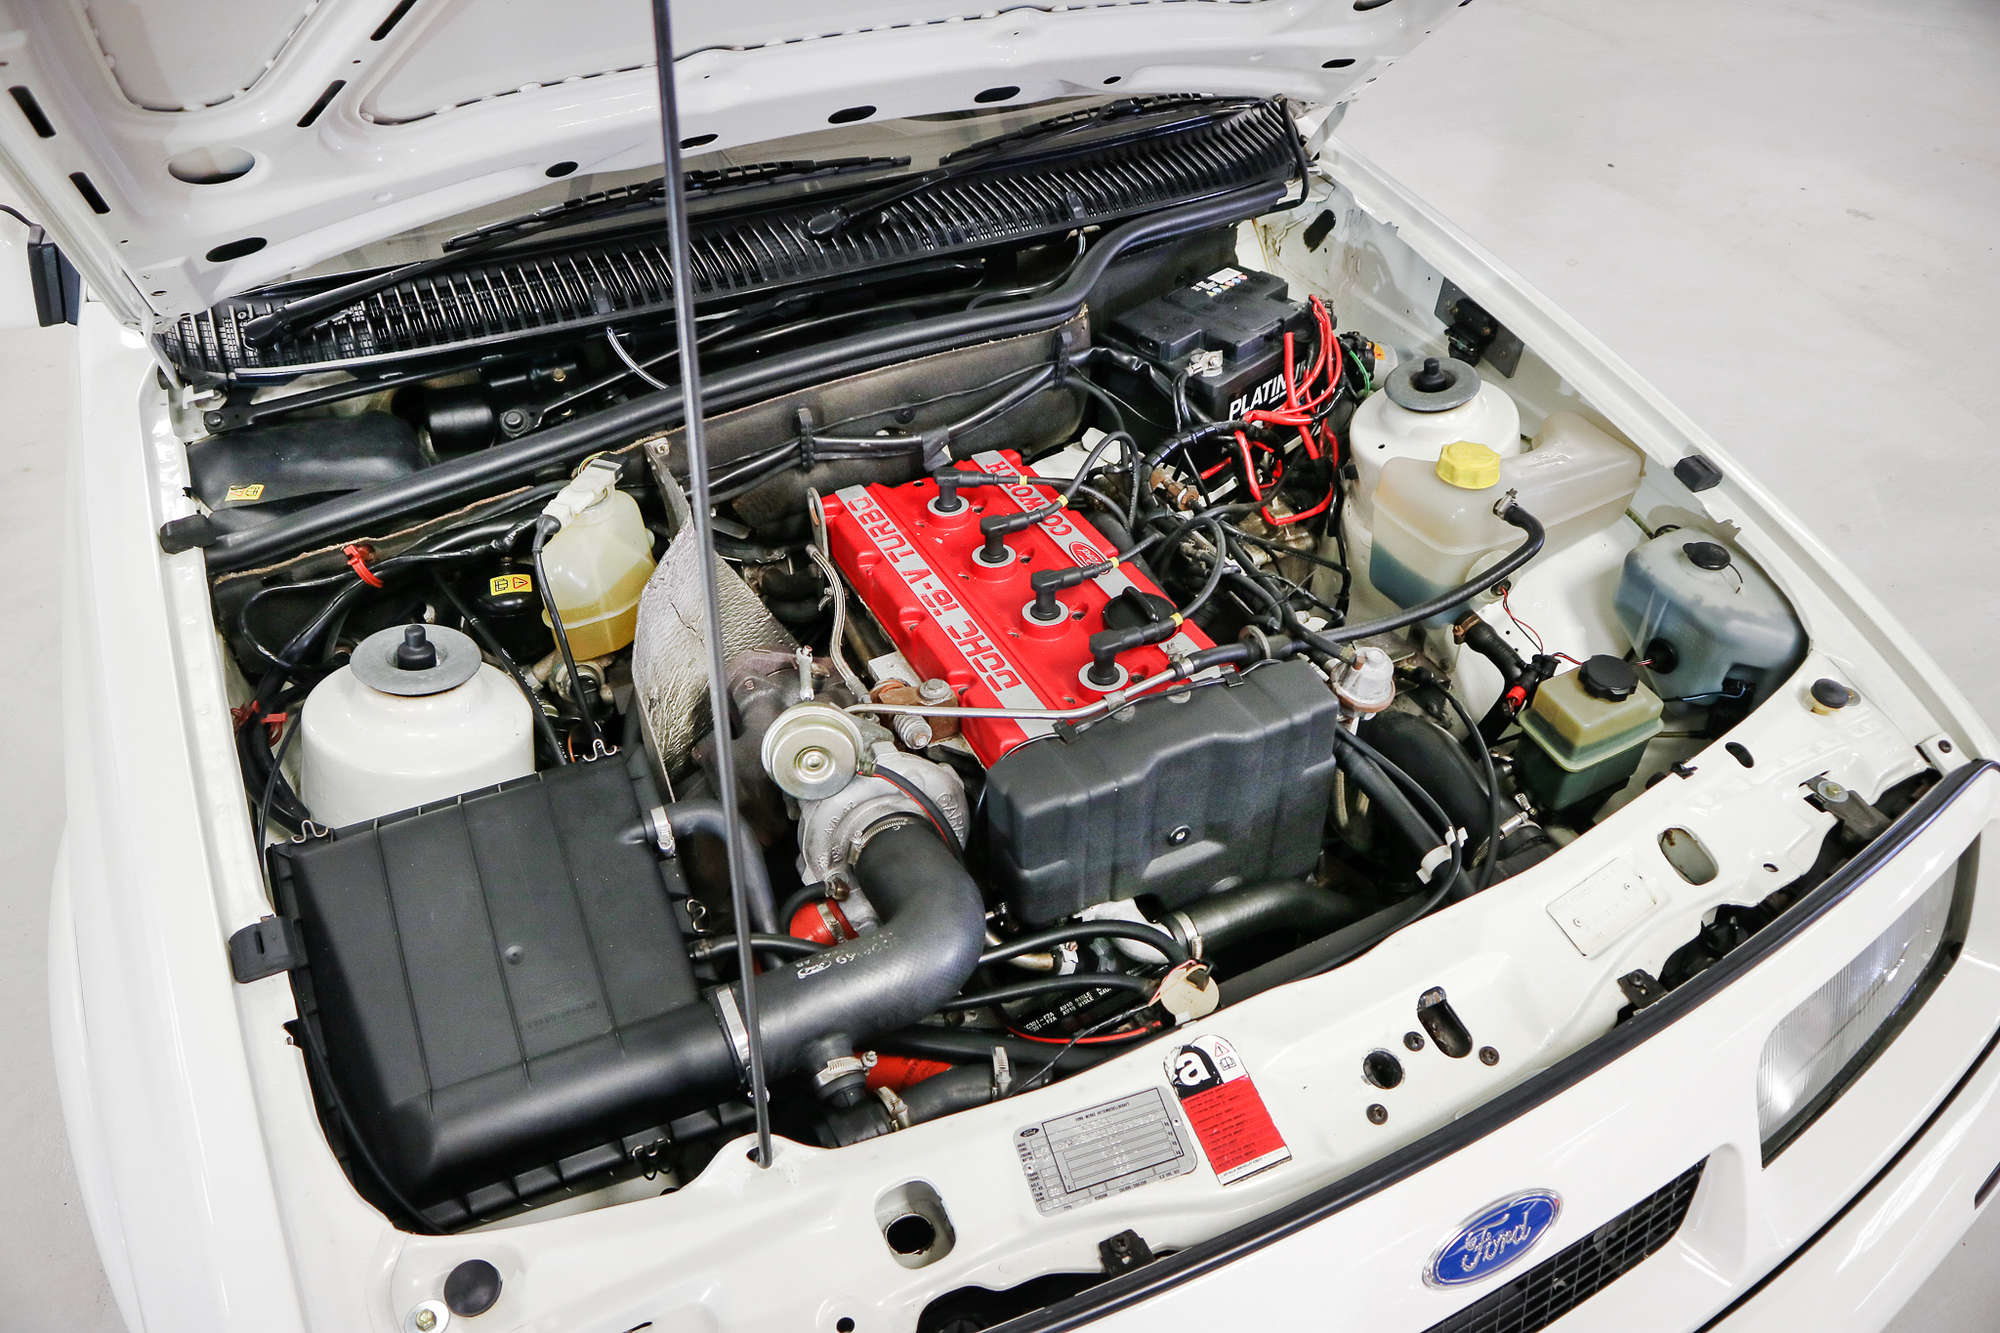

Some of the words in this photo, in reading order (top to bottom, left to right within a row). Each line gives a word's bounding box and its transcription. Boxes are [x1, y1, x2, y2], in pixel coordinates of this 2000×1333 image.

[1229, 359, 1309, 421] PLATIN
[847, 496, 915, 564] TURBO
[902, 568, 960, 617] 16-V
[946, 620, 1022, 692] DOHC
[1177, 1051, 1212, 1086] a
[1460, 1210, 1532, 1272] Ford
